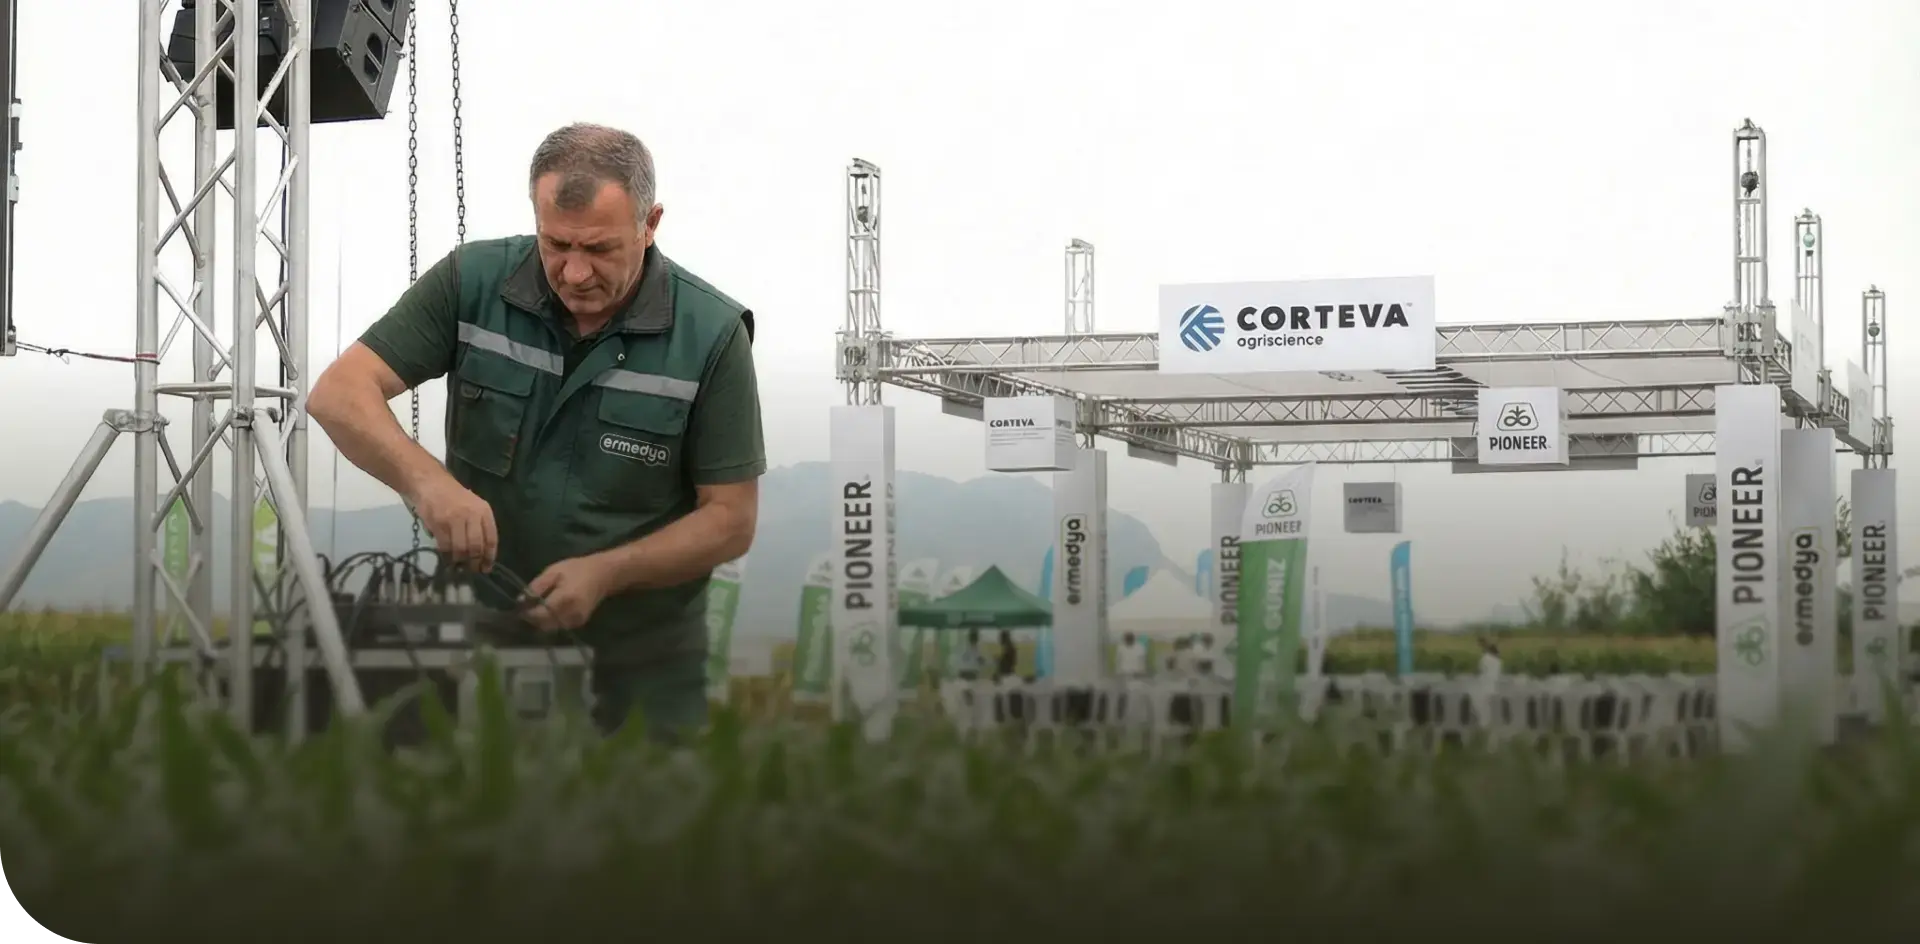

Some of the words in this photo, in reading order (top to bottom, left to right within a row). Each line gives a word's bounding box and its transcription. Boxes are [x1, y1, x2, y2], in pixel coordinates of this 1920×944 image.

[1237, 303, 1409, 331] CORTEVA
[1237, 333, 1324, 350] agriscience
[603, 437, 667, 461] ermedya
[1489, 435, 1547, 450] PIONEER
[1693, 506, 1717, 518] PION
[844, 481, 873, 610] PIONEER
[1732, 466, 1764, 605] PIONEER
[1220, 535, 1241, 626] PIONEER
[1863, 524, 1886, 621] PIONEER
